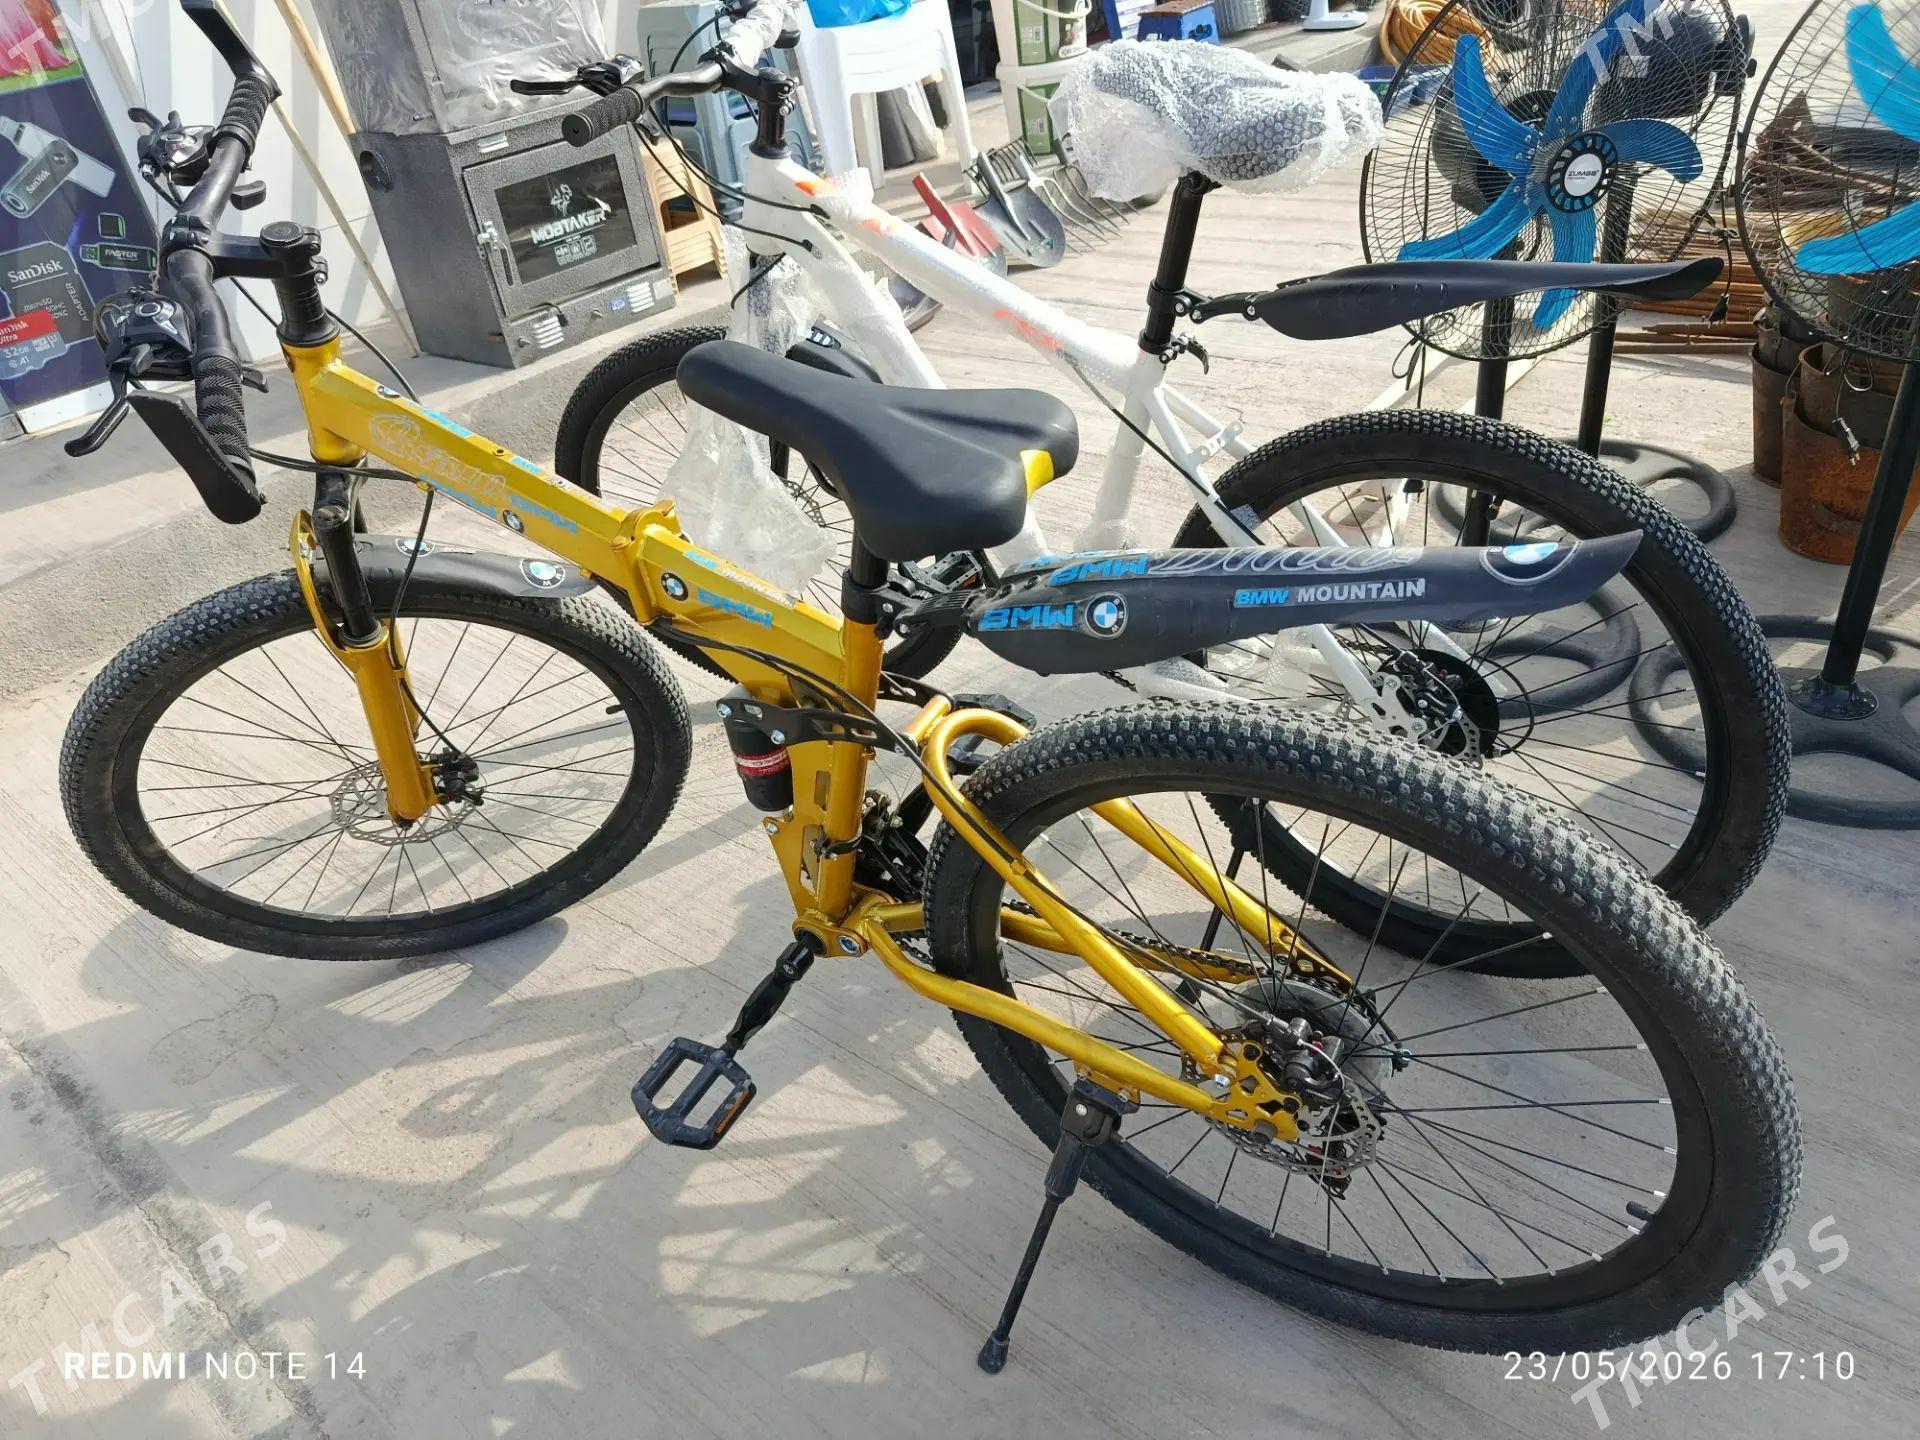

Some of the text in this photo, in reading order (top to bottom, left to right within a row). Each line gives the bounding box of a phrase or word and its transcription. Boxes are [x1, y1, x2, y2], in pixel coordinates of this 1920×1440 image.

[26, 168, 51, 194] SanDisk
[7, 259, 64, 283] SanDisk
[65, 282, 89, 322] ADAPTER
[0, 320, 29, 335] anDisk
[1050, 555, 1149, 587] BMW
[1236, 578, 1426, 606] BMW MOUNTAIN
[980, 602, 1075, 630] BMW
